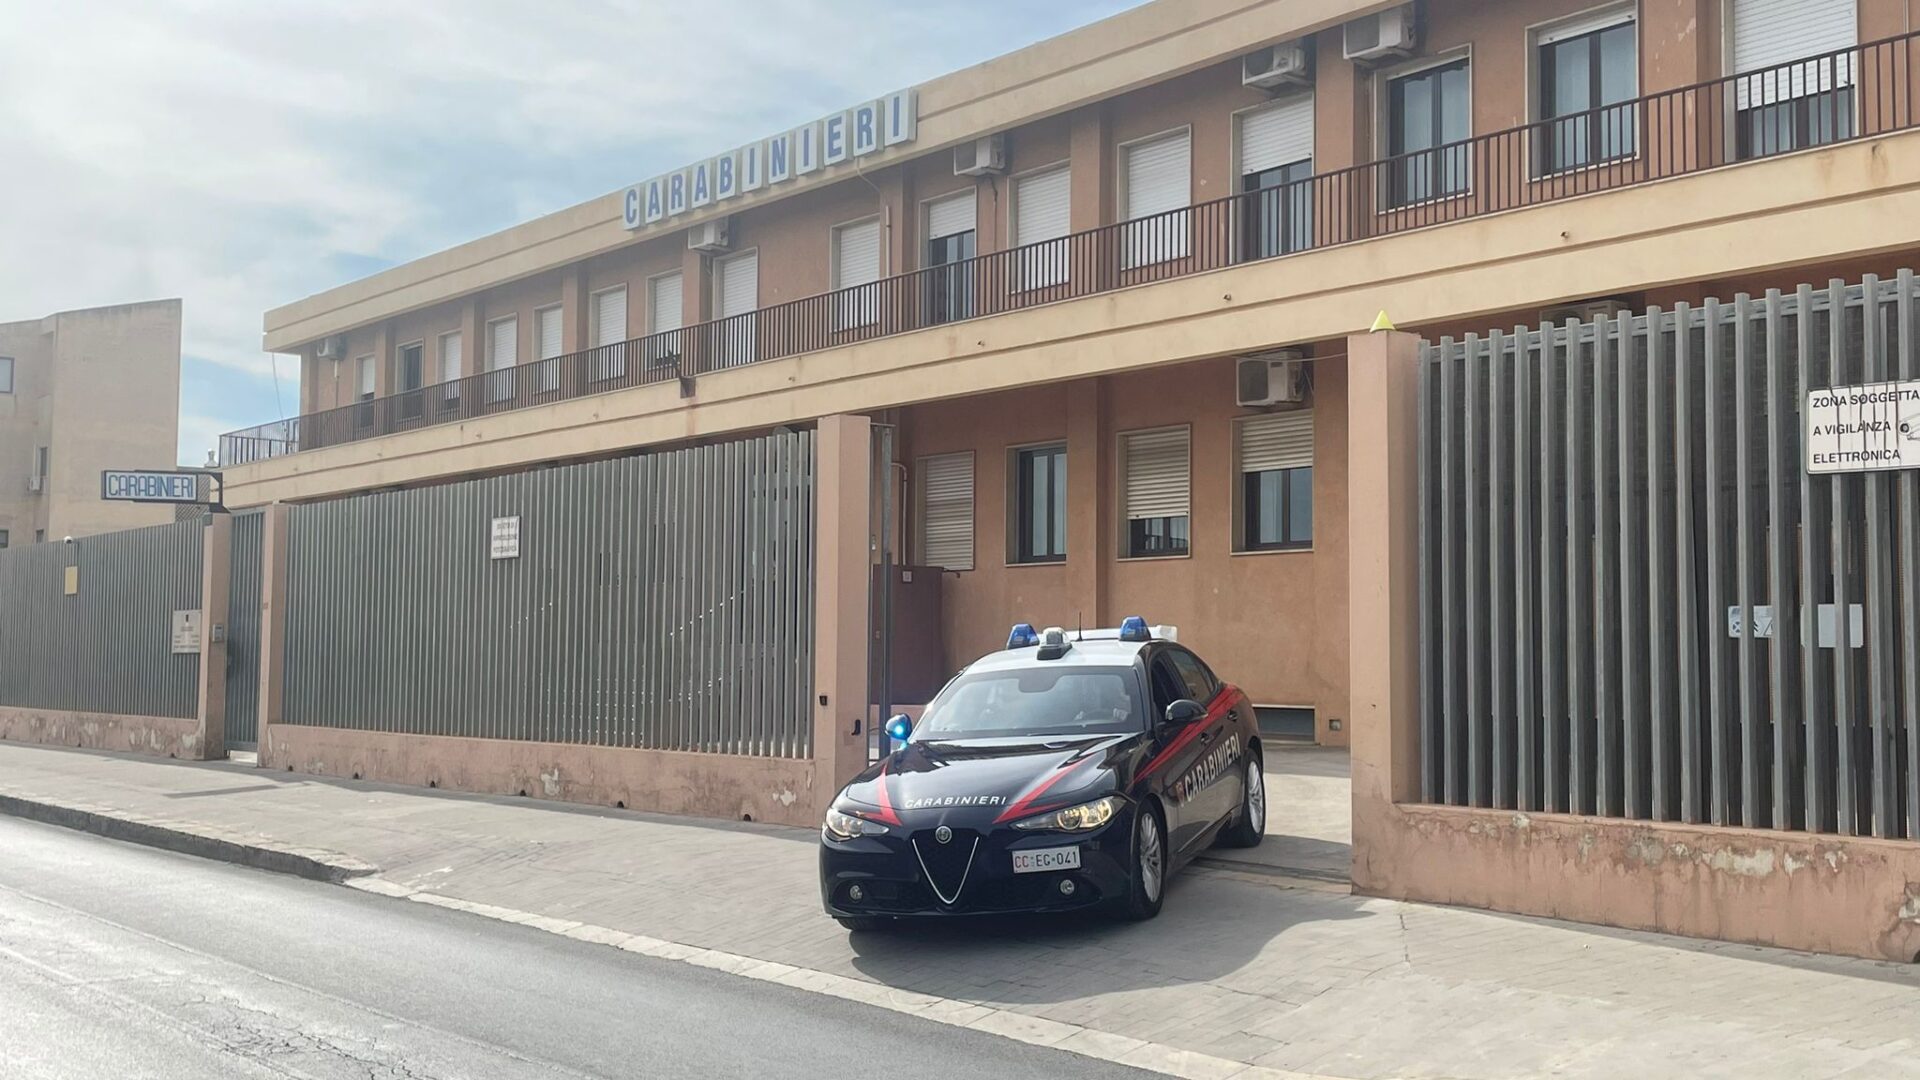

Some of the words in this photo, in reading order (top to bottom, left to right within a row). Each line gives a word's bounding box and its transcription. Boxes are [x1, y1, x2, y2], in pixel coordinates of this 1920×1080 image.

[625, 96, 900, 224] CARABINIERI
[1813, 396, 1847, 408] ZONA
[1850, 390, 1920, 405] SOGGETTA
[1813, 426, 1821, 436] A
[1825, 421, 1891, 435] VIGILANZA
[1813, 449, 1901, 464] ELETTRONICA
[108, 475, 193, 498] CARABINIERI
[1184, 732, 1241, 802] CARABINIERI
[904, 796, 1006, 808] CARABINIERI
